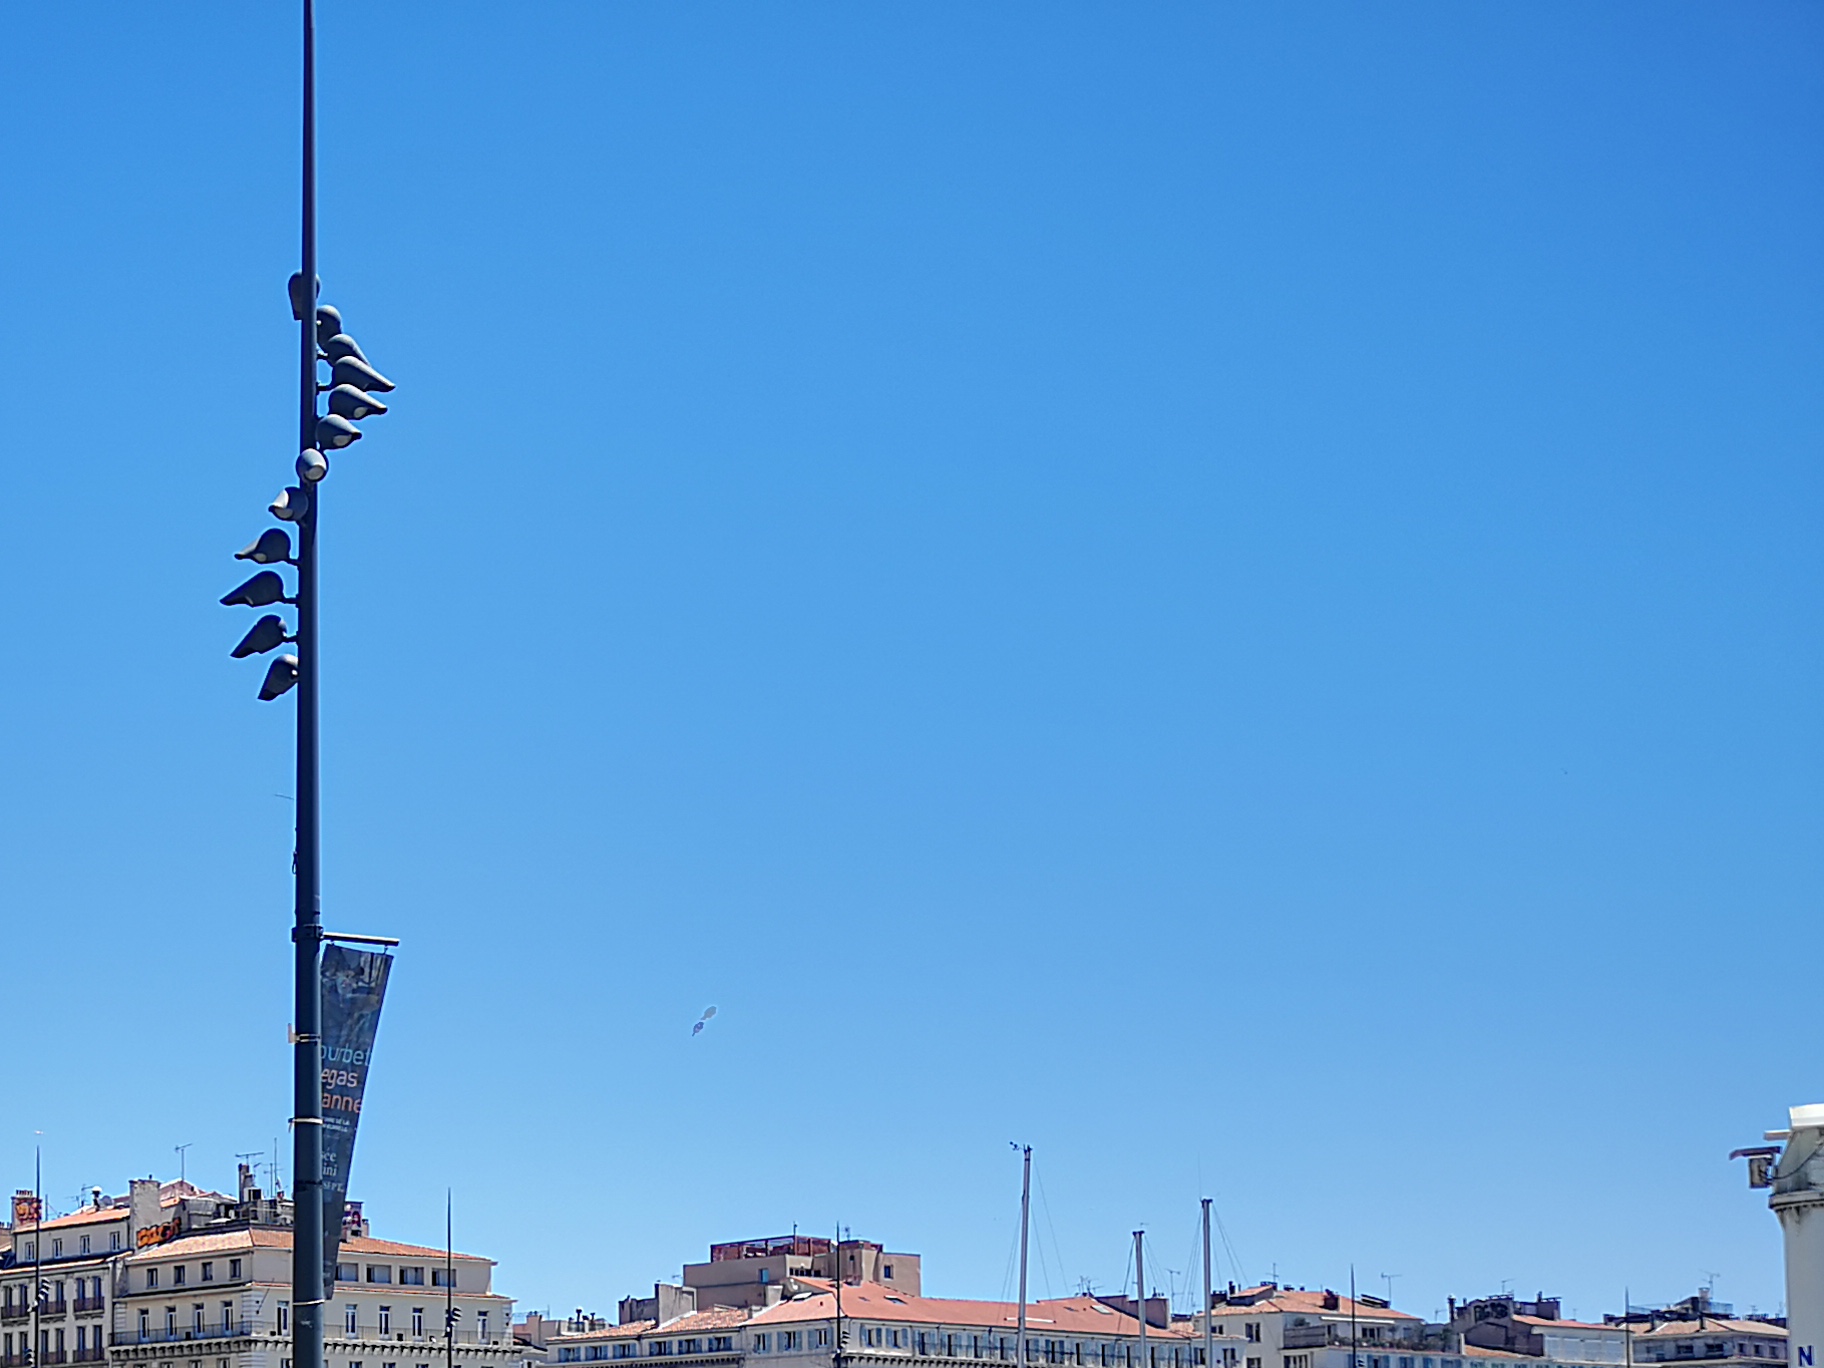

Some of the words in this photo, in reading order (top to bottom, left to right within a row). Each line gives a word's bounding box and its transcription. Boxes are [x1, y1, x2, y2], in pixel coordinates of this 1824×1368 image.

[321, 1043, 371, 1066] ourbet
[321, 1068, 358, 1090] egas
[321, 1092, 362, 1114] anne
